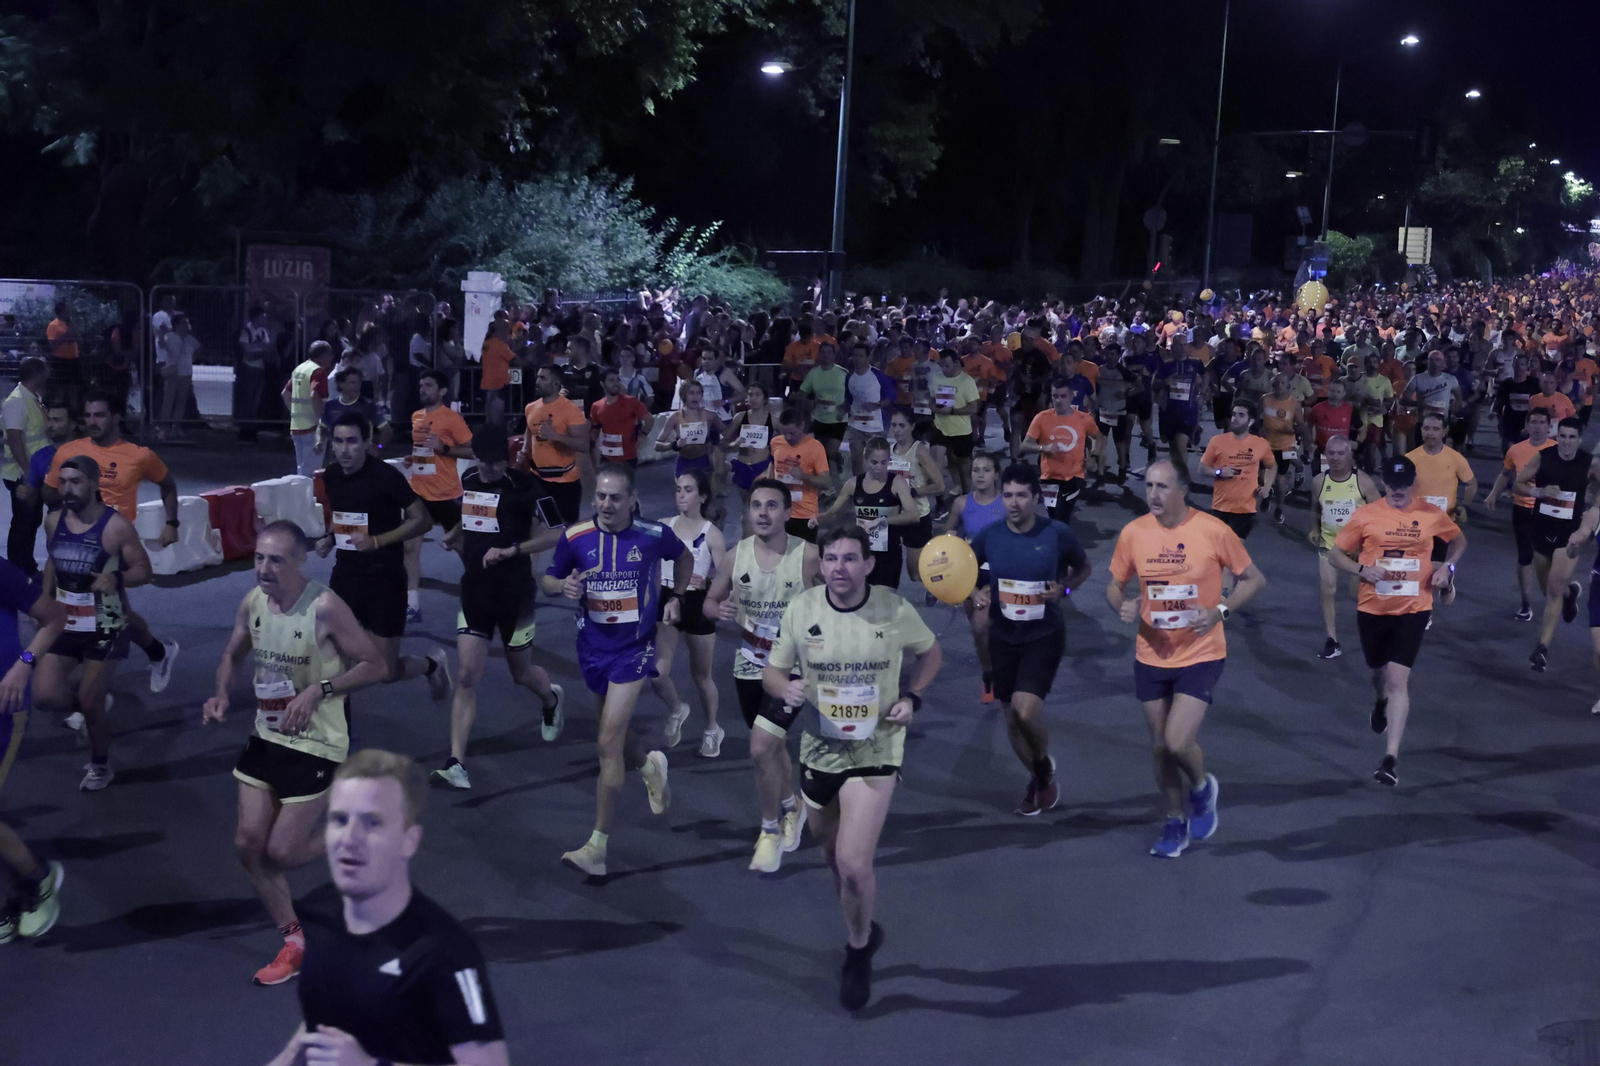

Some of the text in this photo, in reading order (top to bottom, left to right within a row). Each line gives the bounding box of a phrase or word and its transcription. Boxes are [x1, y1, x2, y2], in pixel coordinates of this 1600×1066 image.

[264, 259, 314, 280] LUZIA
[745, 432, 763, 440] 20222
[857, 507, 879, 517] ASM
[1329, 508, 1350, 516] 17526
[1390, 571, 1407, 581] 792
[586, 579, 640, 592] MIRAFLORES
[1013, 594, 1031, 605] 713
[602, 600, 623, 611] 908
[1162, 600, 1187, 611] 1246
[745, 608, 785, 619] MIRAFLORE
[806, 659, 891, 672] AMIGOS PIRÁMIDE
[817, 673, 877, 685] MIRAFLORES
[830, 704, 869, 719] 21879
